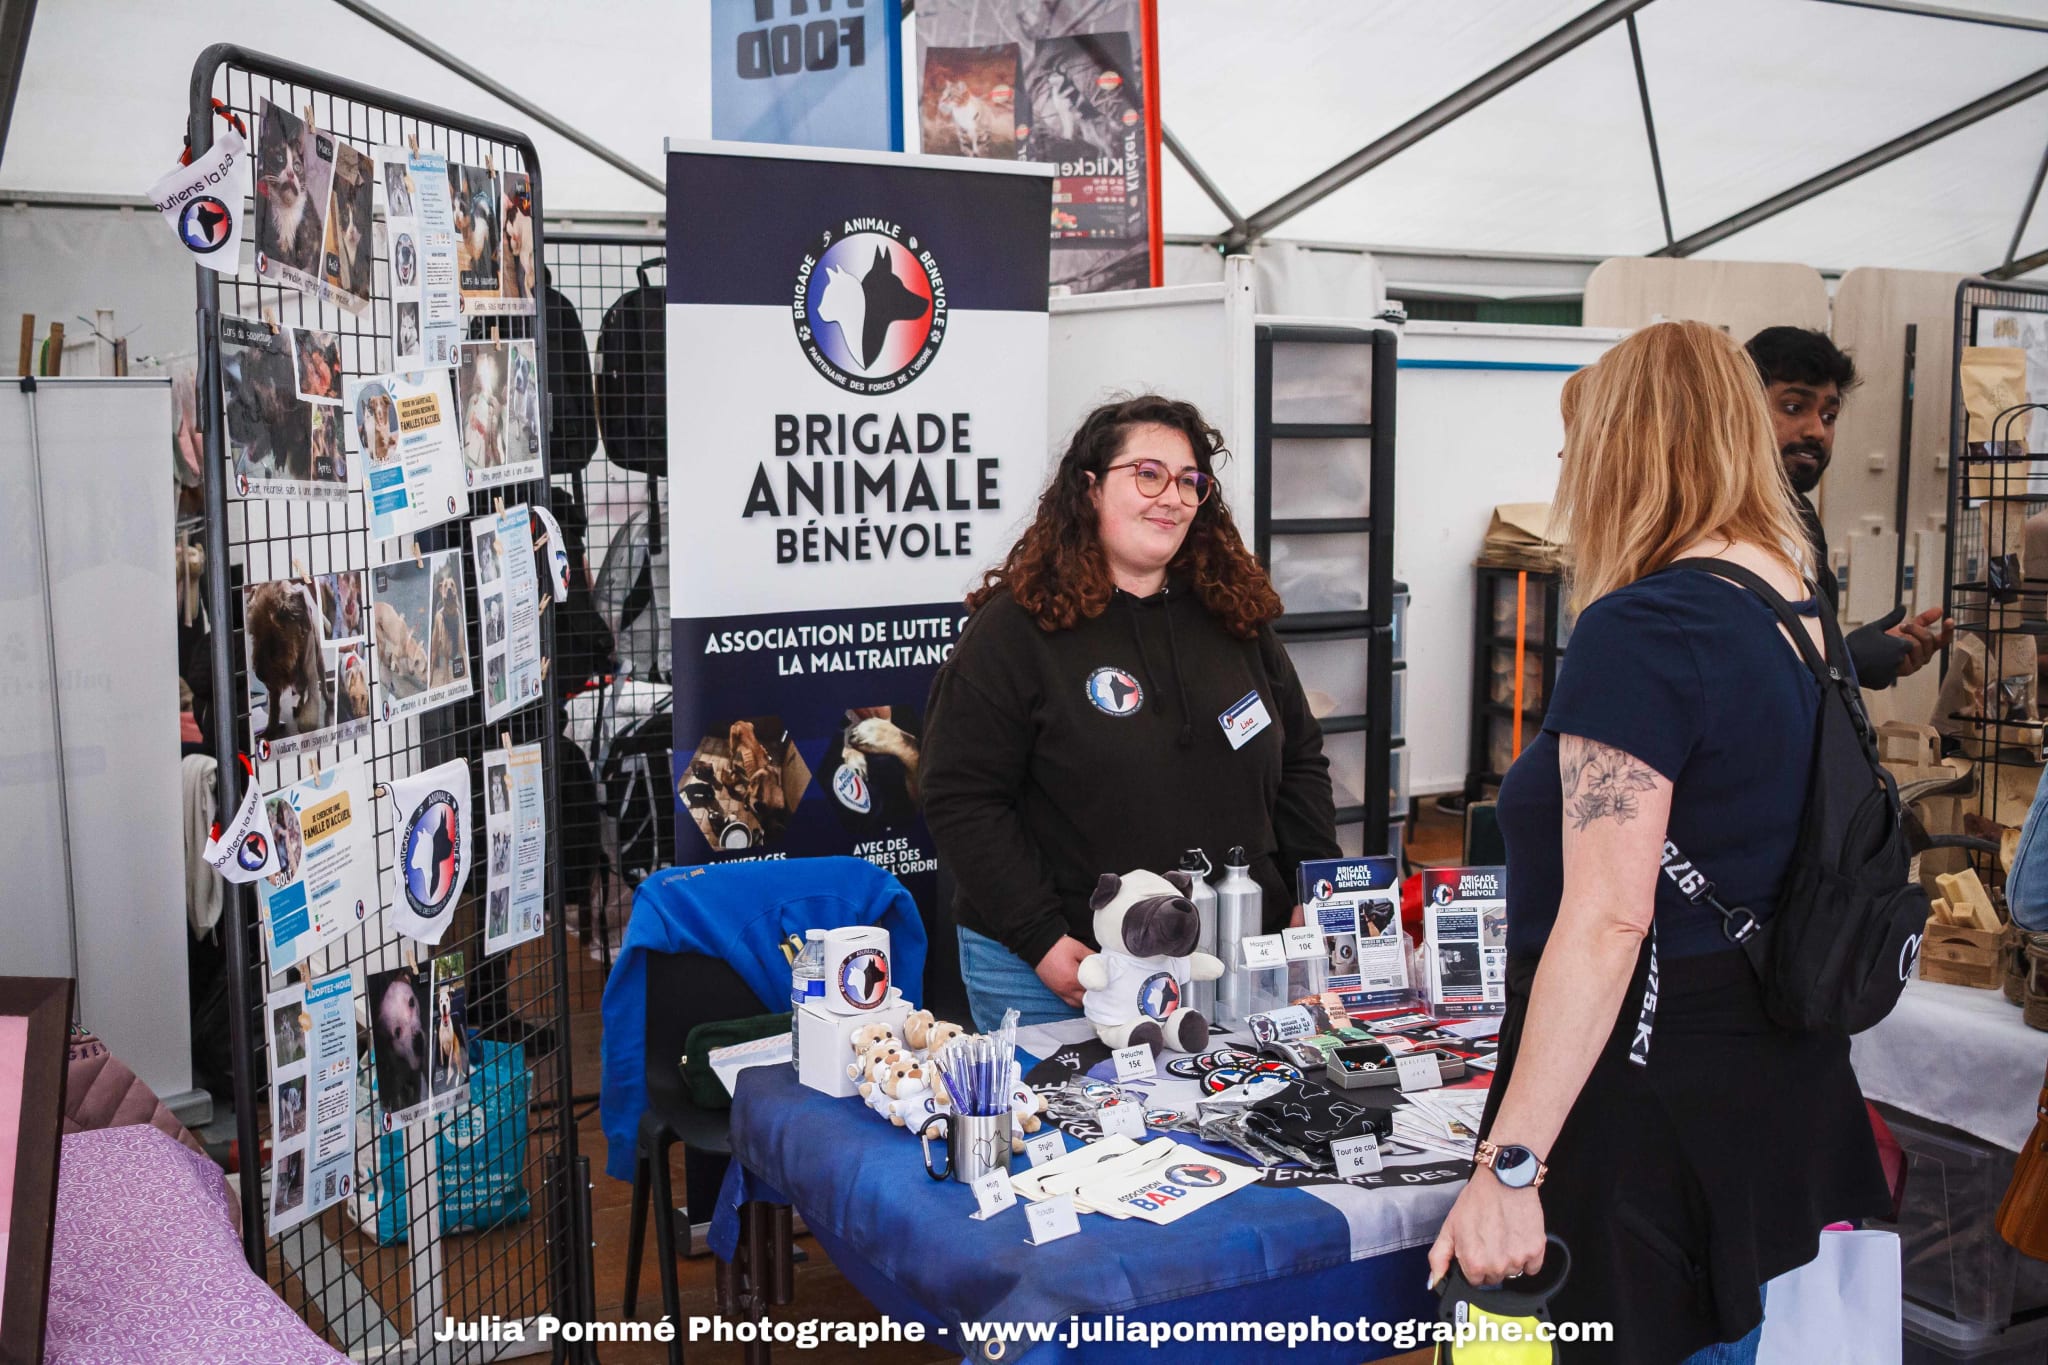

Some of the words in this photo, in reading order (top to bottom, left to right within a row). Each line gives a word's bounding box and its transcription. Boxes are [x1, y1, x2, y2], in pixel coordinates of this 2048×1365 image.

[204, 172, 221, 186] la
[843, 217, 901, 239] ANIMALE
[794, 254, 816, 319] BRIGADE
[919, 250, 946, 328] BENEVOLE
[808, 346, 847, 385] PARTENAIRE
[850, 380, 865, 391] DES
[868, 379, 896, 392] FORCES
[897, 373, 908, 384] DE
[775, 412, 972, 457] BRIGADE
[742, 457, 1000, 519] ANIMALE
[776, 517, 972, 564] BÉNÉVOLE
[704, 623, 853, 654] ASSOCIATION
[861, 621, 887, 643] DE
[892, 616, 951, 641] LUTTE
[778, 654, 804, 676] LA
[811, 643, 955, 674] MALTRAITANC
[1240, 717, 1254, 730] Lisa
[242, 816, 251, 828] la
[303, 819, 326, 840] FAMILLE
[326, 808, 351, 829] D'ACCUEIL
[853, 841, 884, 856] AVEC
[887, 838, 909, 851] DES
[858, 852, 896, 865] BRES
[900, 848, 921, 862] DES
[1334, 870, 1371, 882] ANIMALE
[1336, 864, 1369, 874] BRIGADE
[274, 868, 293, 889] BOLT
[1458, 880, 1499, 890] ANIMALE
[1461, 874, 1496, 882] BRIGADE
[1249, 940, 1273, 948] Magnet
[1292, 932, 1314, 941] Gourde
[1299, 942, 1312, 950] 10€
[307, 978, 352, 1000] ADOPTEZ-NOUS
[1120, 1049, 1144, 1059] Peluche
[1128, 1060, 1142, 1069] 15€
[1038, 1141, 1054, 1152] Stylo
[1336, 1146, 1352, 1157] Tour
[1354, 1145, 1363, 1153] de
[1364, 1144, 1377, 1152] cou
[1353, 1157, 1364, 1166] 6€
[1257, 1166, 1385, 1184] TENARE
[1400, 1169, 1458, 1184] DES
[1117, 1180, 1162, 1203] ASSOCIATION
[1129, 1185, 1187, 1211] BAB
